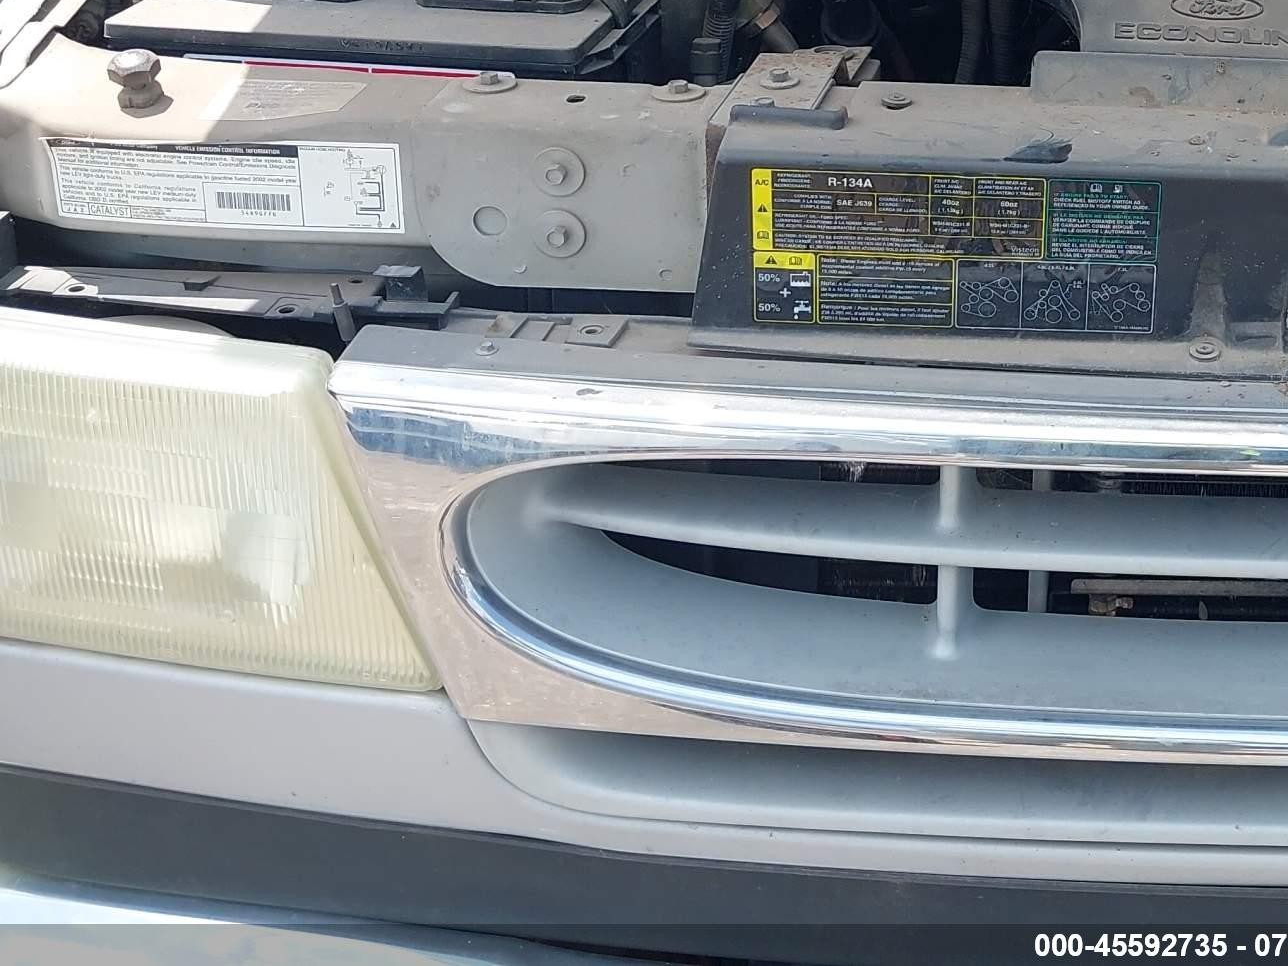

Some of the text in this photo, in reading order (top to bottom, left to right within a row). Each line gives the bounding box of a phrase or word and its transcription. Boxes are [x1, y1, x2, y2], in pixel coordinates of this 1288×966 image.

[828, 177, 873, 188] R-134A
[836, 199, 853, 207] SAE
[90, 205, 129, 216] CATALYST
[1010, 245, 1040, 253] Visteon
[758, 273, 780, 282] 50%
[758, 303, 781, 312] 50%
